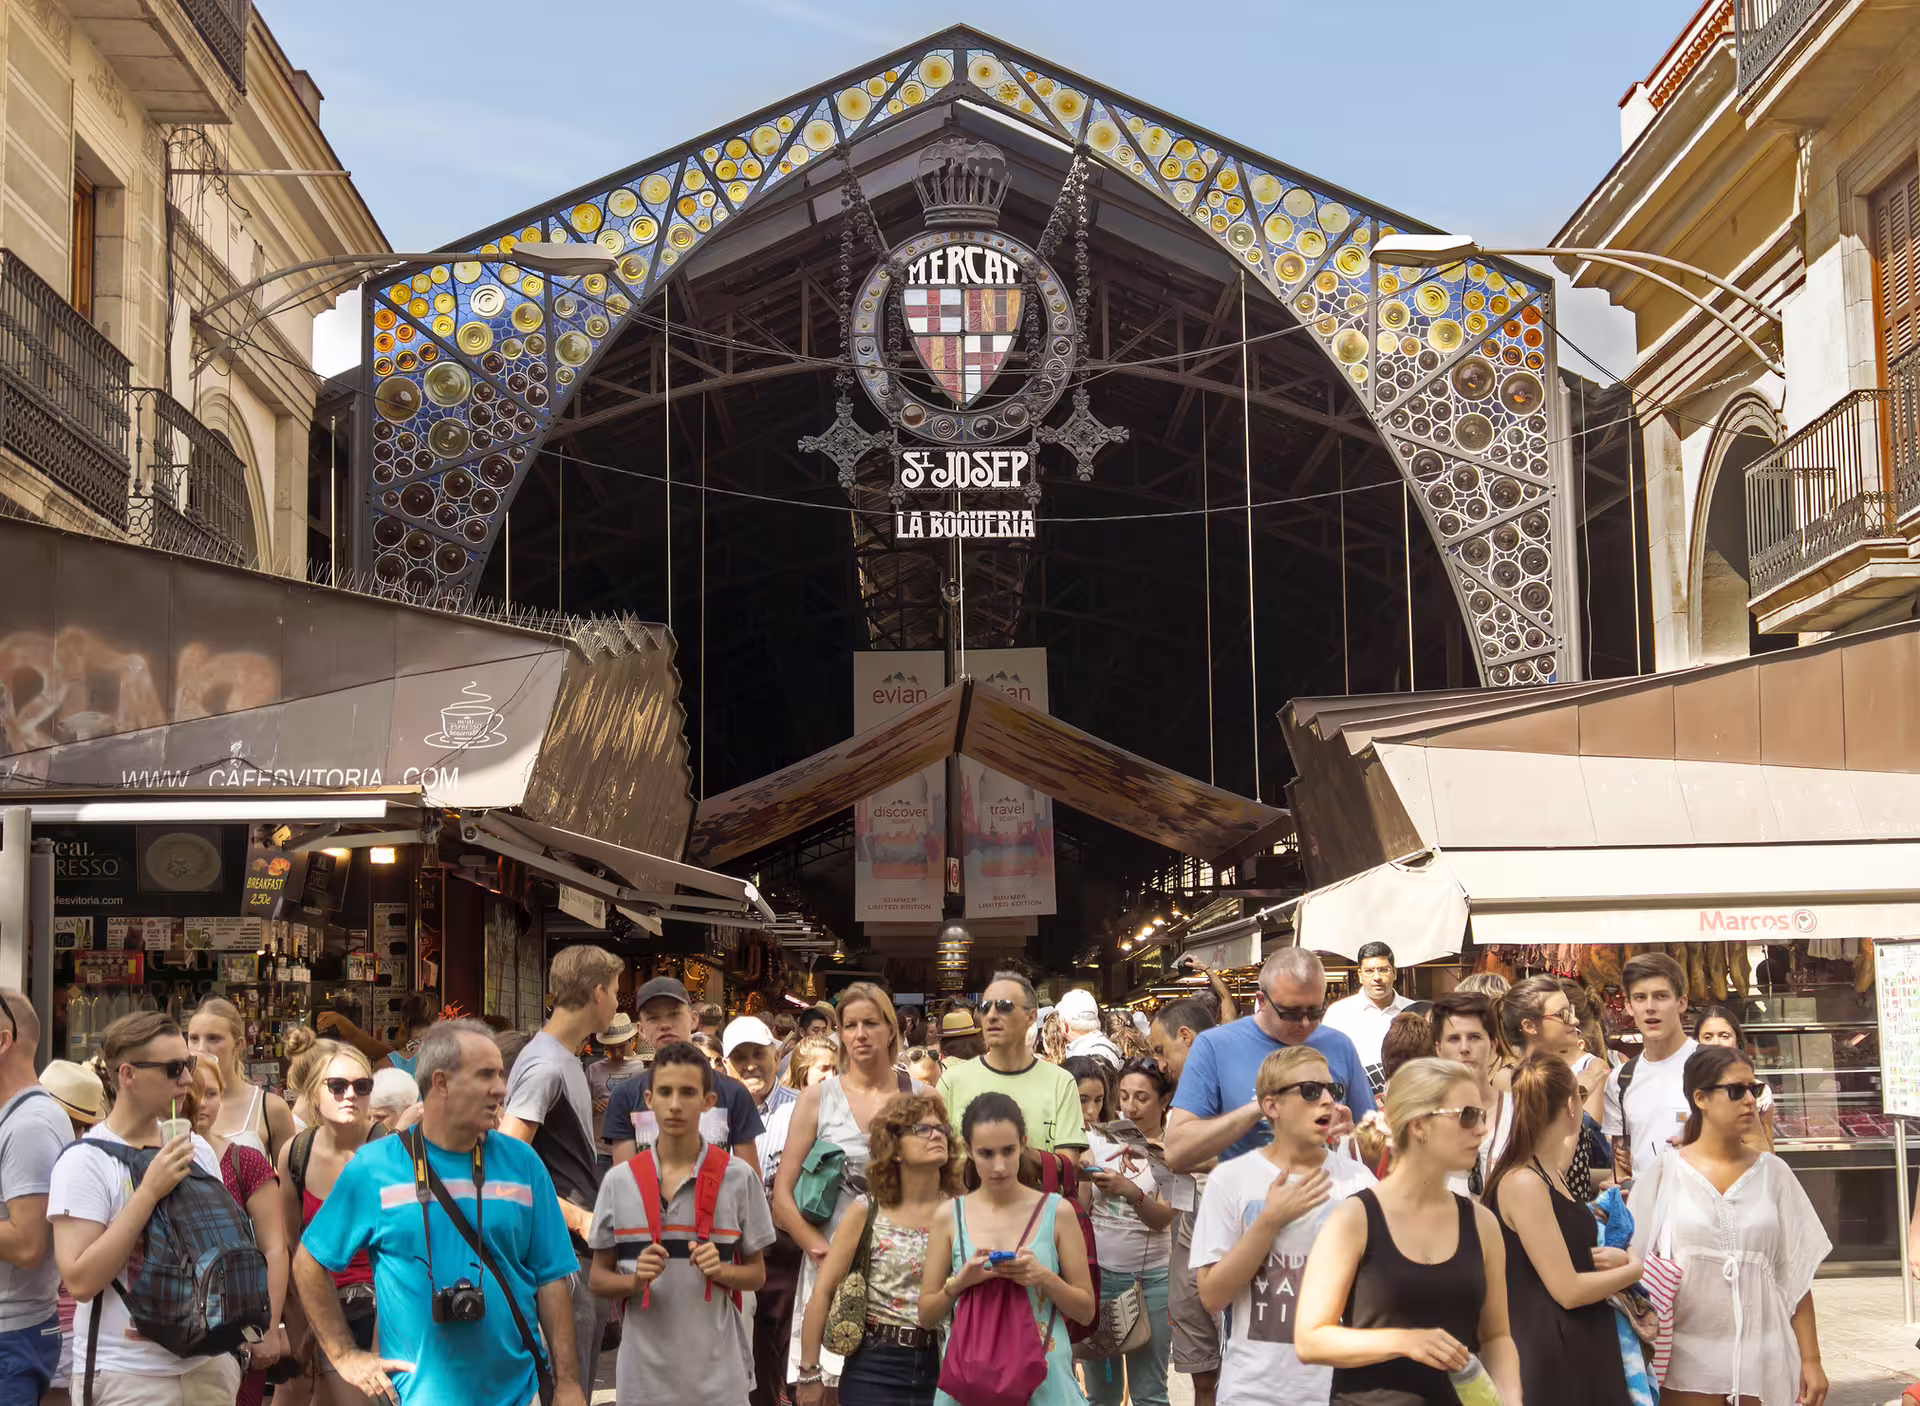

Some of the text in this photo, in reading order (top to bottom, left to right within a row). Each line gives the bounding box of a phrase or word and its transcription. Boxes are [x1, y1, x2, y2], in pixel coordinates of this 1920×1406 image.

[907, 246, 1019, 285] MERCAT
[930, 451, 1029, 489] JOSEP
[896, 510, 1036, 538] LA BOQUERIA
[872, 686, 928, 704] evian
[873, 806, 928, 818] discover
[990, 803, 1025, 815] travel
[246, 877, 284, 891] BREAKFAST
[1011, 900, 1042, 908] EDITION
[1699, 910, 1790, 931] Marcos
